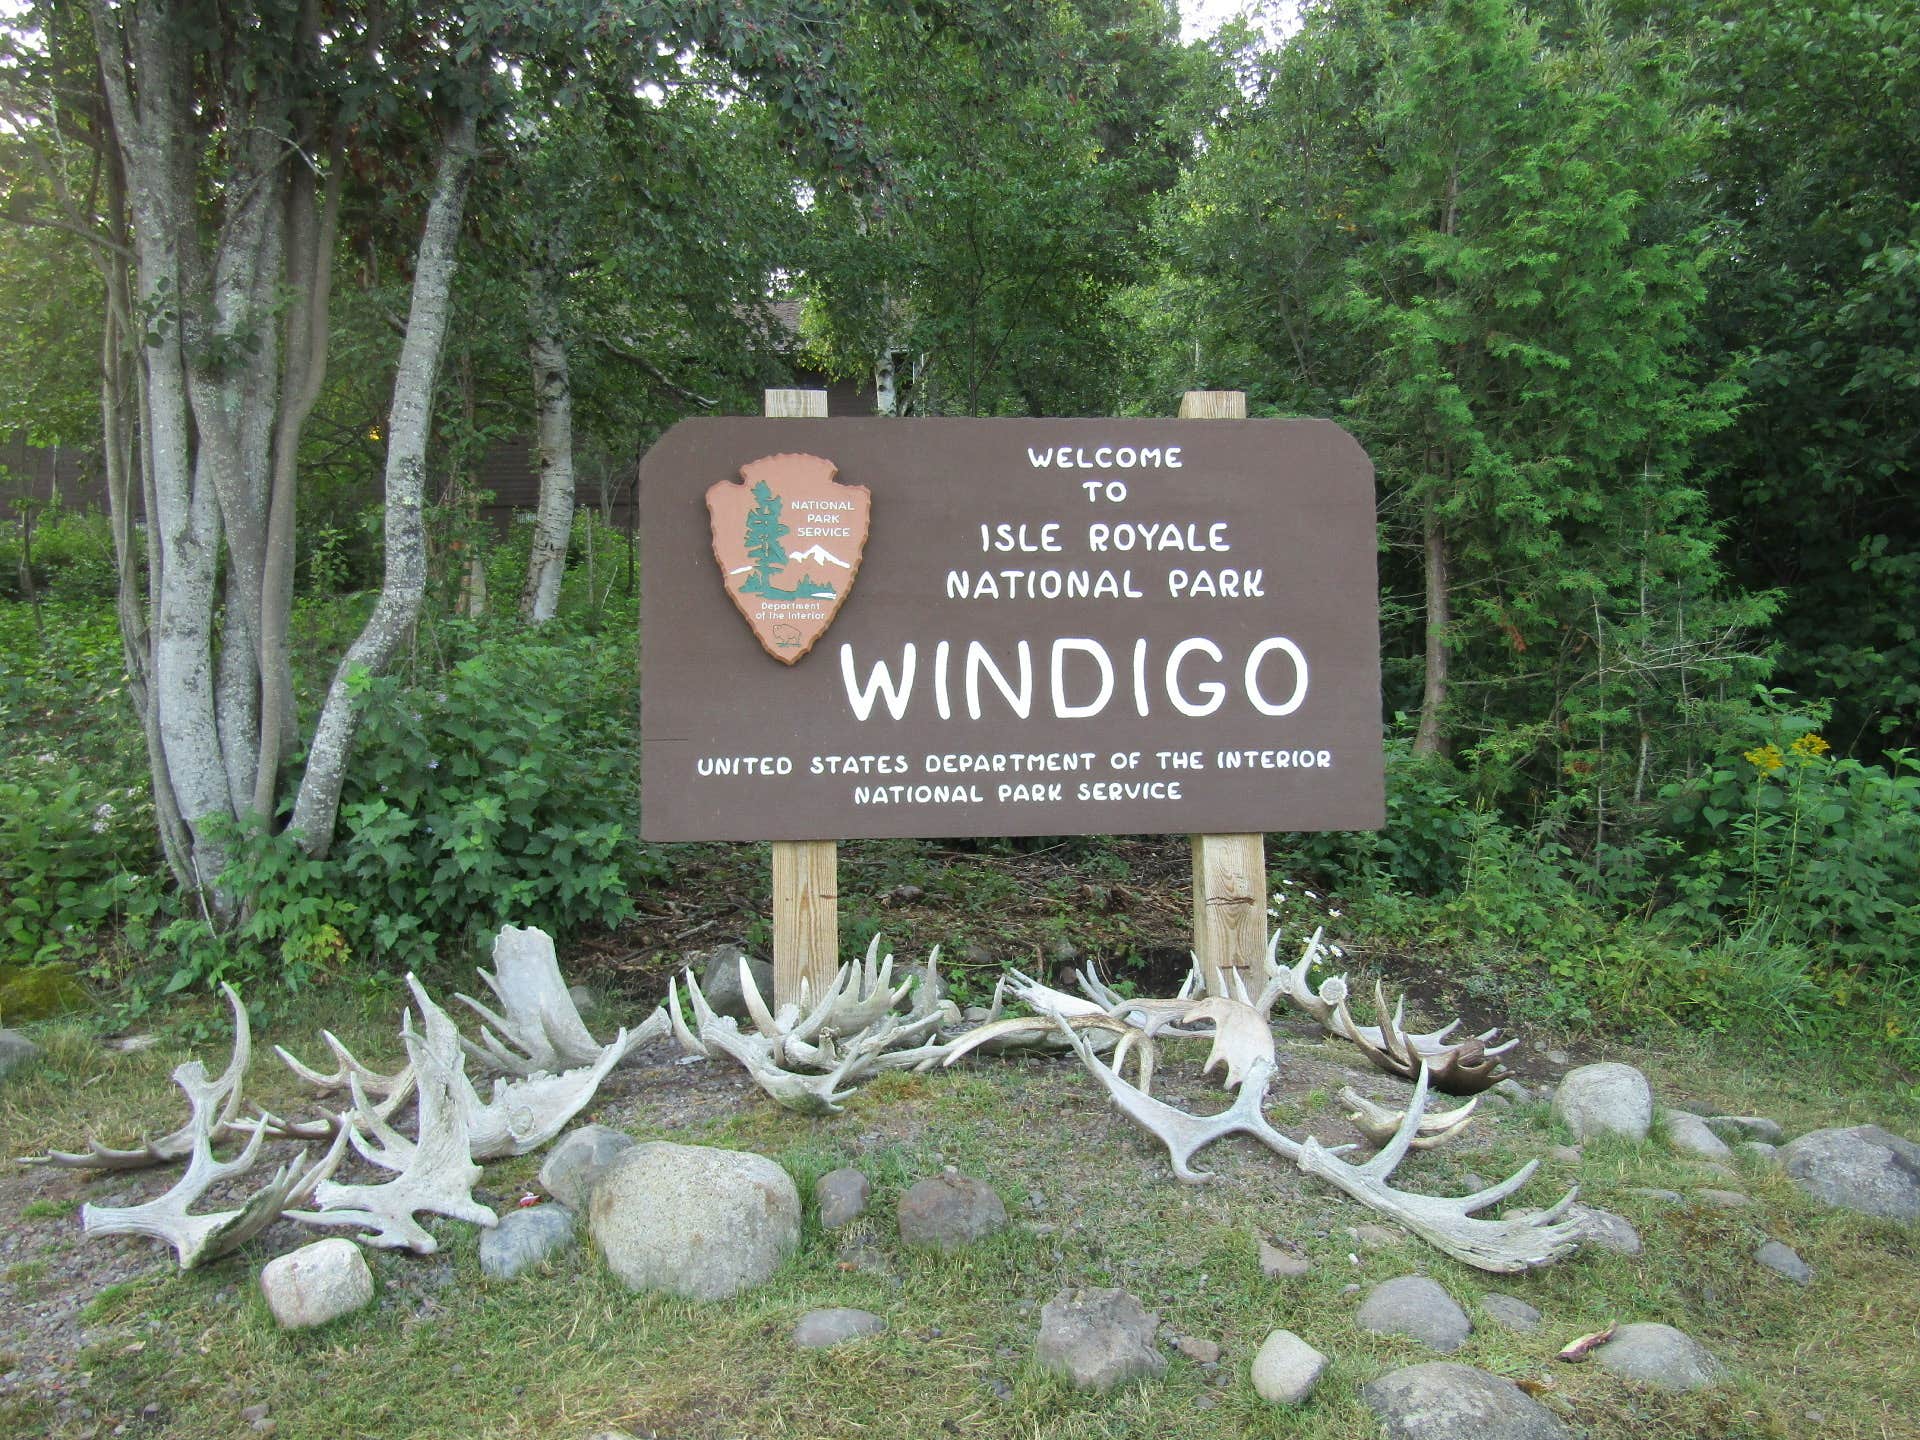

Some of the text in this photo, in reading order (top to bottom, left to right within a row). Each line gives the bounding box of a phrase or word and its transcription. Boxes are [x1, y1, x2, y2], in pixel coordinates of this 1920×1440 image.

[1028, 448, 1182, 468] WELCOME
[1083, 482, 1126, 502] TO
[792, 501, 854, 510] NATIONAL
[808, 514, 839, 523] PARK
[797, 528, 850, 537] SERVICE
[981, 523, 1230, 552] ISLE ROYALE
[947, 569, 1264, 599] NATIONAL PARK
[756, 612, 825, 621] of the Interior
[762, 602, 820, 612] Department
[841, 637, 1308, 721] WINDIGO
[698, 751, 1330, 776] UNITED STATES DEPARTMENT OF THE INTERIOR
[855, 782, 1181, 804] NATIONAL PARK SERVICE
